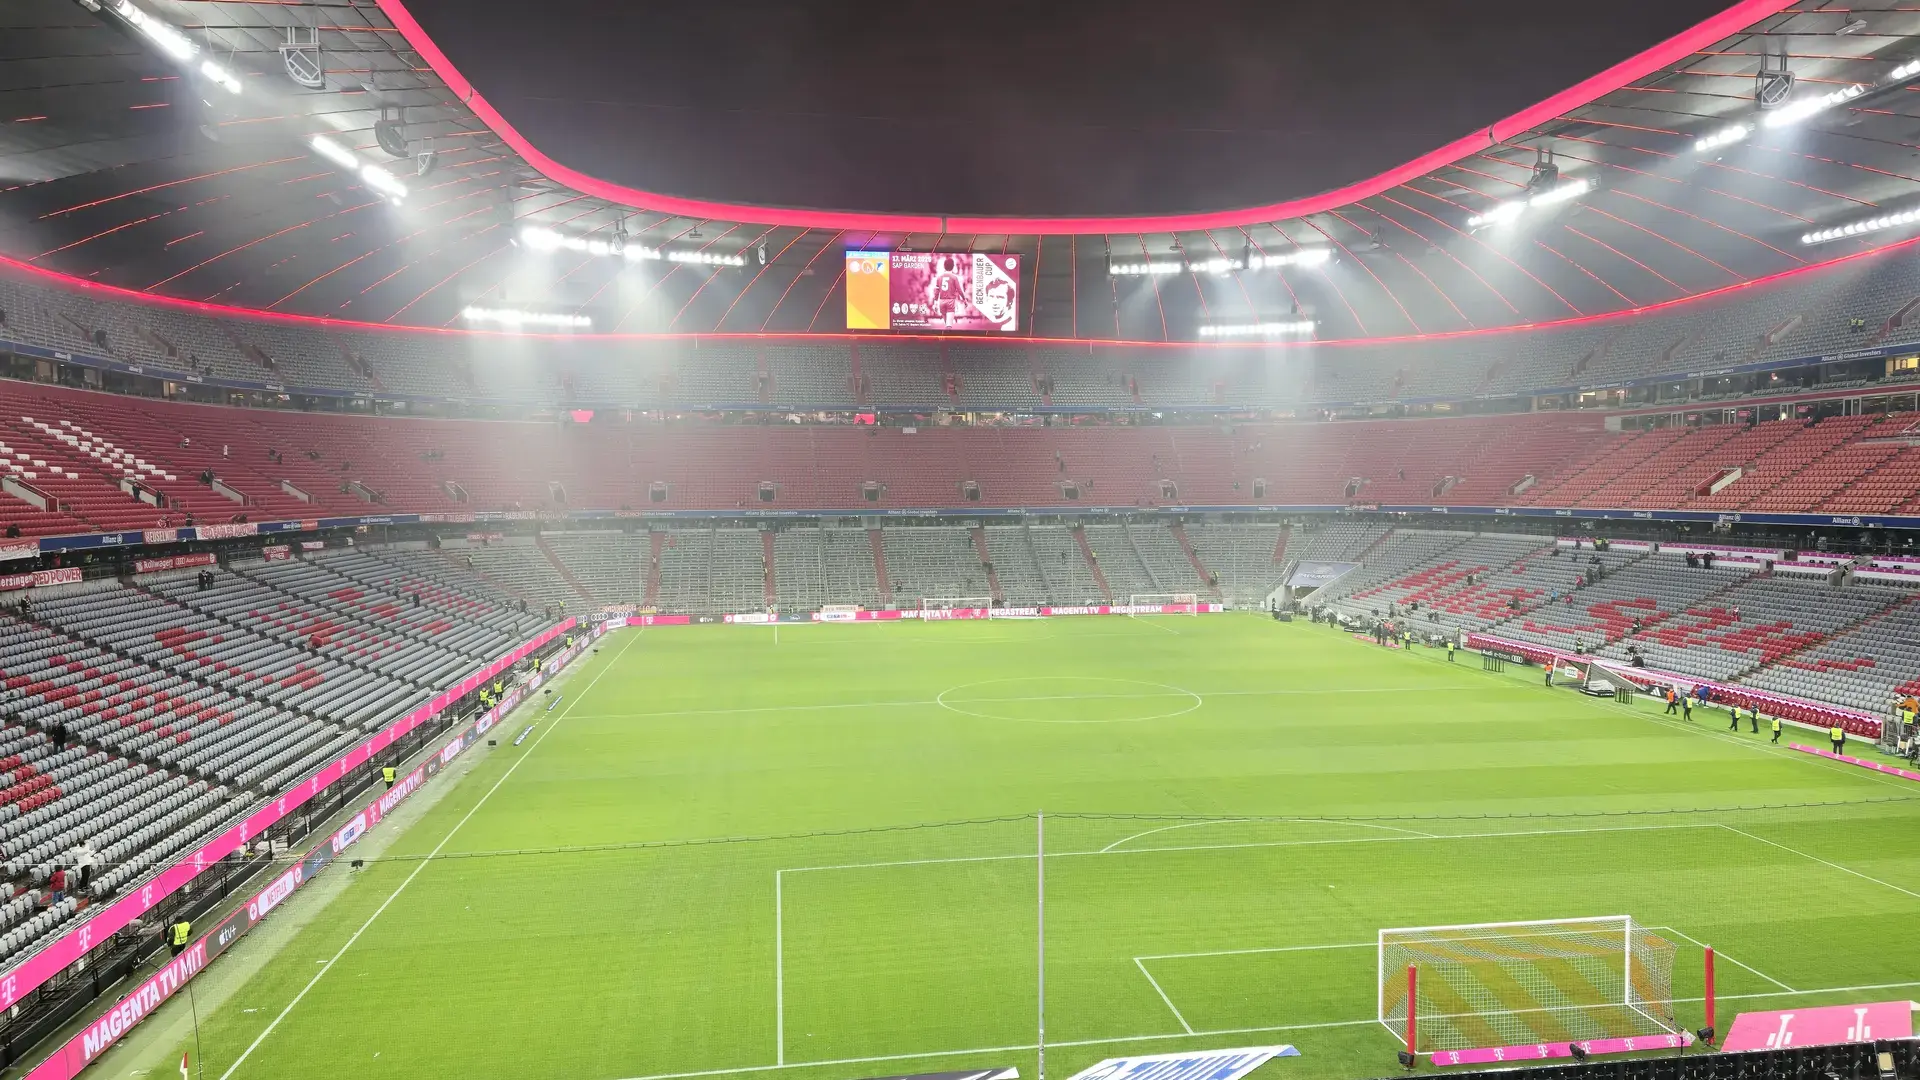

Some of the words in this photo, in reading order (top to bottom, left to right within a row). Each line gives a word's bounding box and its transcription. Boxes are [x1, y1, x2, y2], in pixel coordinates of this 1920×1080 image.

[941, 276, 950, 291] 5
[102, 536, 116, 544] Allianz
[33, 571, 50, 585] RED
[52, 568, 81, 584] POWER
[941, 609, 952, 618] TV
[380, 785, 407, 815] MAGENTA
[266, 882, 287, 906] NETFLIX
[224, 924, 236, 942] tv+
[84, 983, 160, 1061] MAGENTA
[160, 966, 178, 992] TV
[177, 944, 203, 981] MIT
